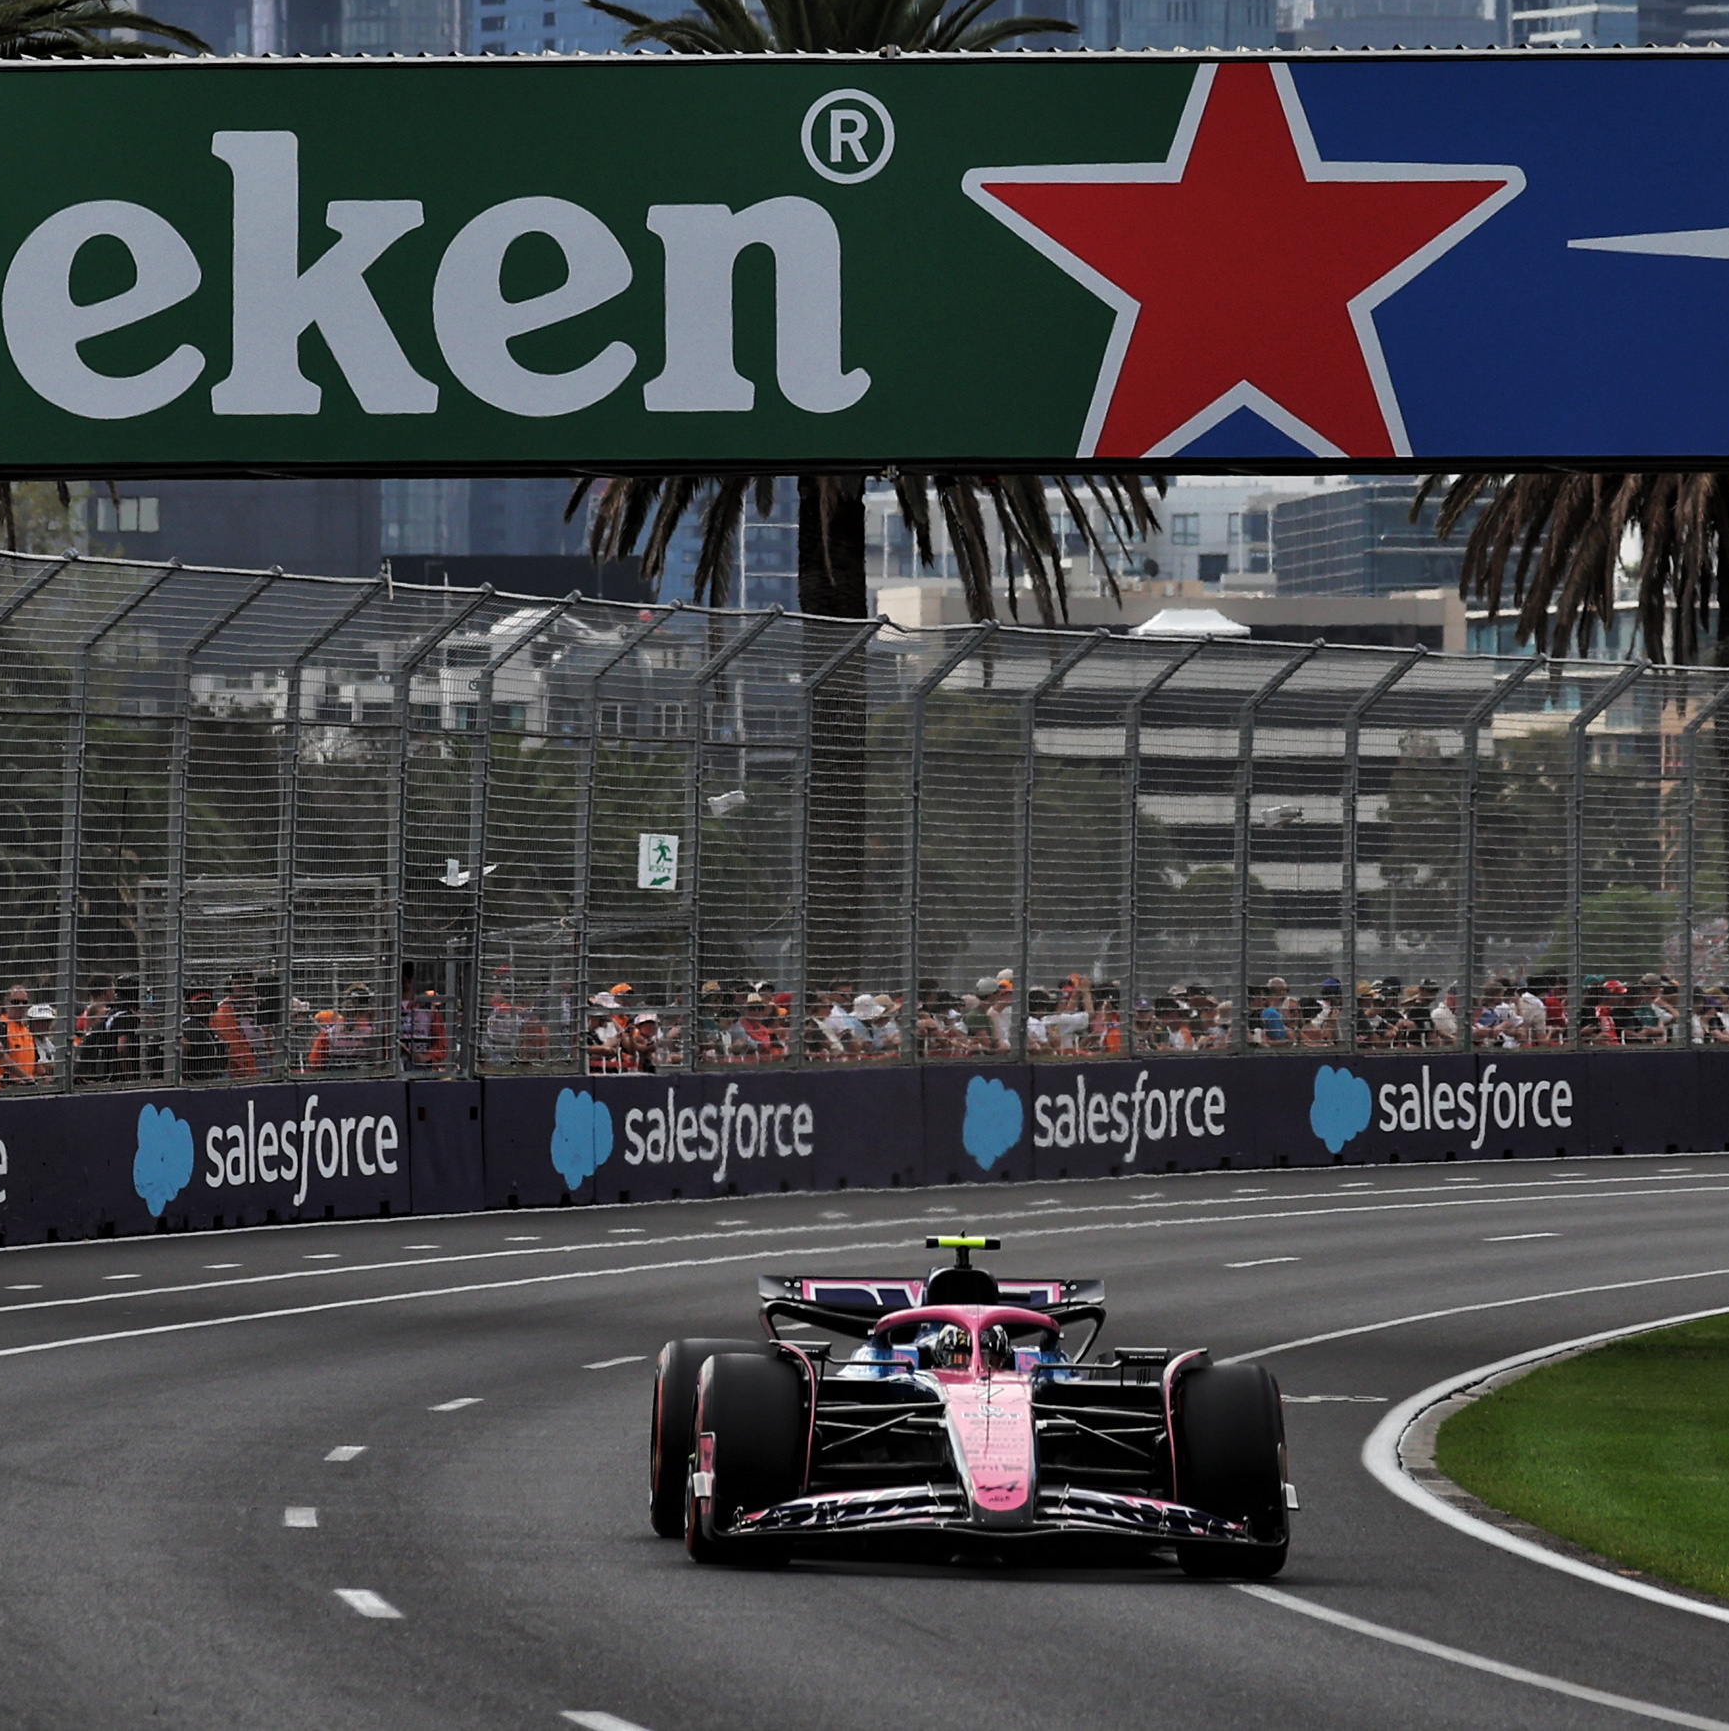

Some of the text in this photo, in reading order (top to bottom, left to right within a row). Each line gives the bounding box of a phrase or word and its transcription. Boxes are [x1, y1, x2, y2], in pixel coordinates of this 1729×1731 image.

[206, 1094, 399, 1206] salesforce
[625, 1083, 814, 1182] salesforce
[1034, 1070, 1226, 1162] salesforce
[1379, 1064, 1572, 1149] salesforce
